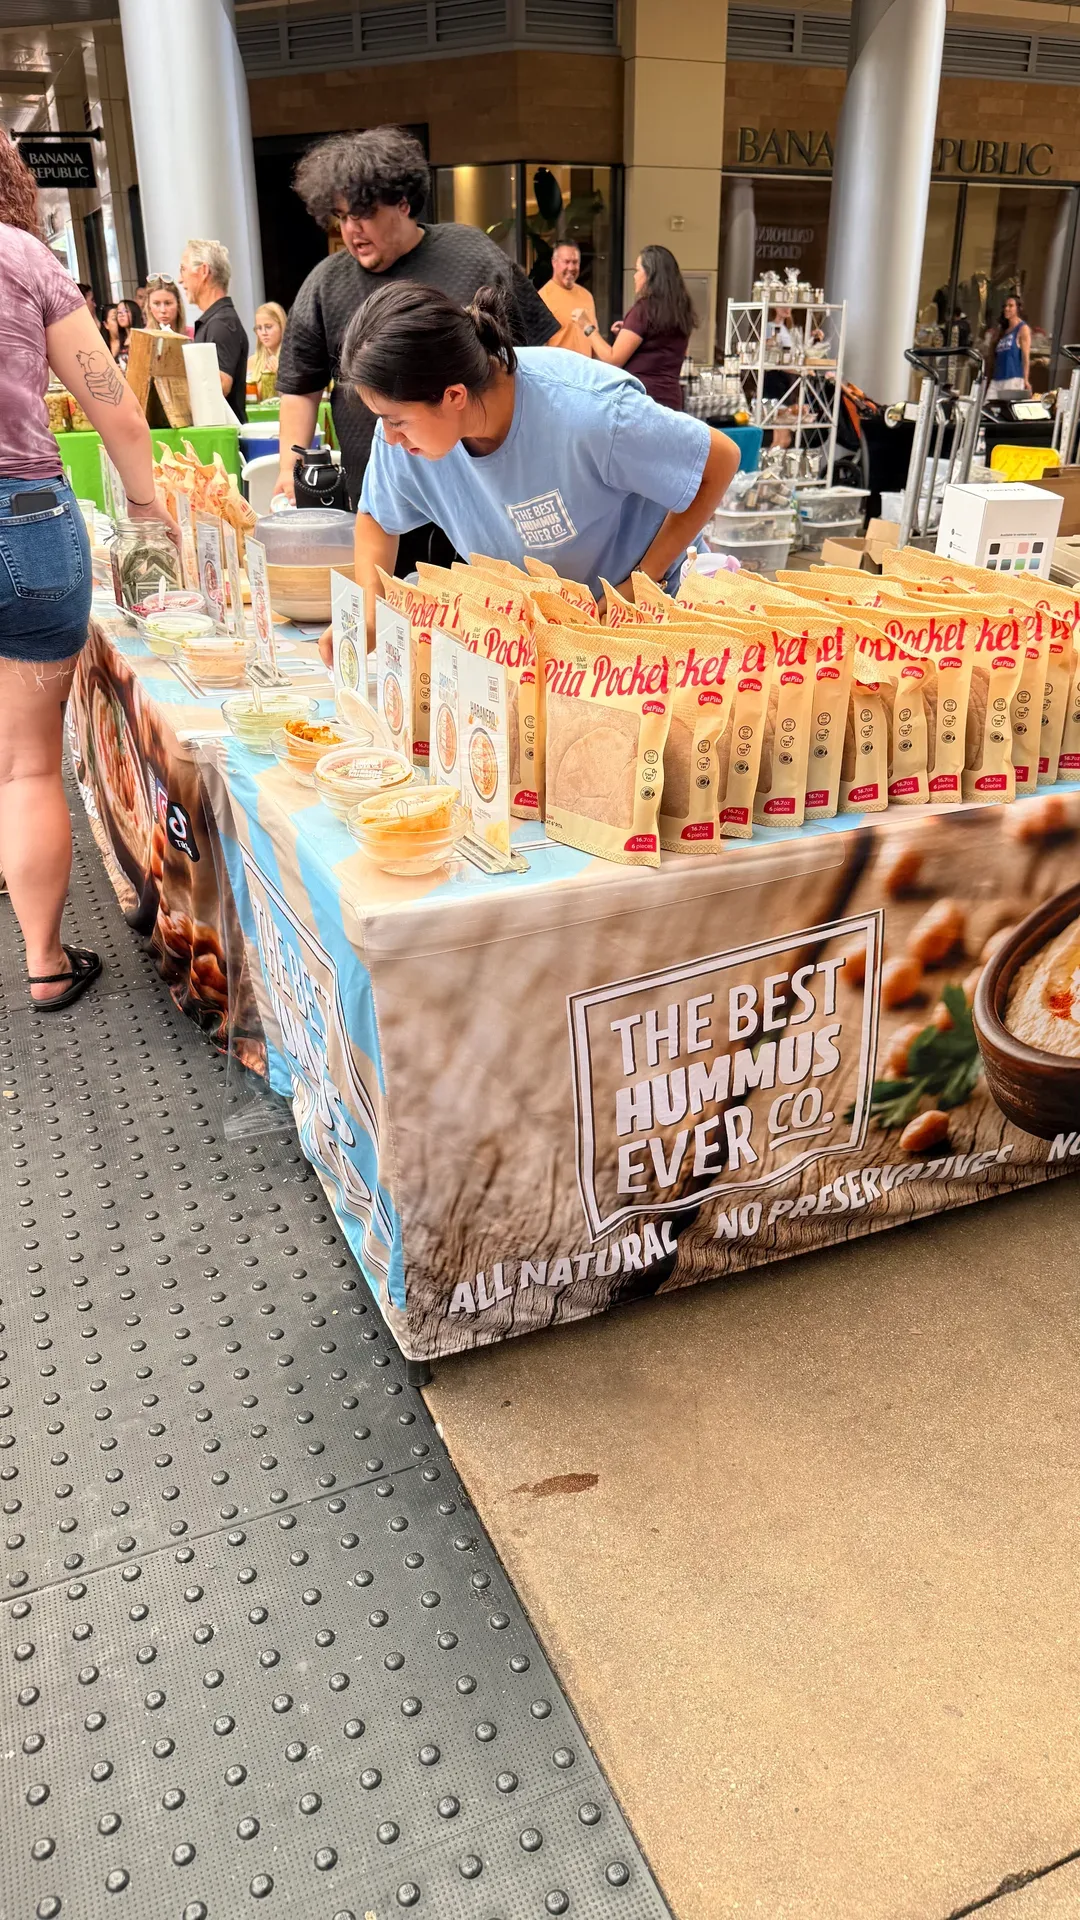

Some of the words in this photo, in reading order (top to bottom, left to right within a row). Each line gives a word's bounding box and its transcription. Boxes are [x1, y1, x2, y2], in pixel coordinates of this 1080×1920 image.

[29, 153, 83, 164] BANANA
[29, 167, 89, 178] REPUBLIC
[737, 127, 834, 167] BANA
[935, 138, 1054, 176] PUBLIC
[515, 509, 534, 520] THE
[533, 500, 556, 517] BEST
[520, 512, 561, 531] HUMMUS
[526, 528, 552, 543] EVER
[545, 658, 586, 698] Pita
[591, 654, 669, 698] Pocket
[252, 893, 292, 1002] THE
[610, 994, 713, 1077] THE
[728, 957, 846, 1041] BEST
[615, 1023, 842, 1137] HUMMUS
[616, 1107, 758, 1194] EVER
[767, 1087, 835, 1136] CO.
[449, 1262, 512, 1318] ALL
[520, 1220, 678, 1288] NATURAL
[714, 1205, 760, 1241] NO
[768, 1144, 1014, 1227] PRESERVATIVES
